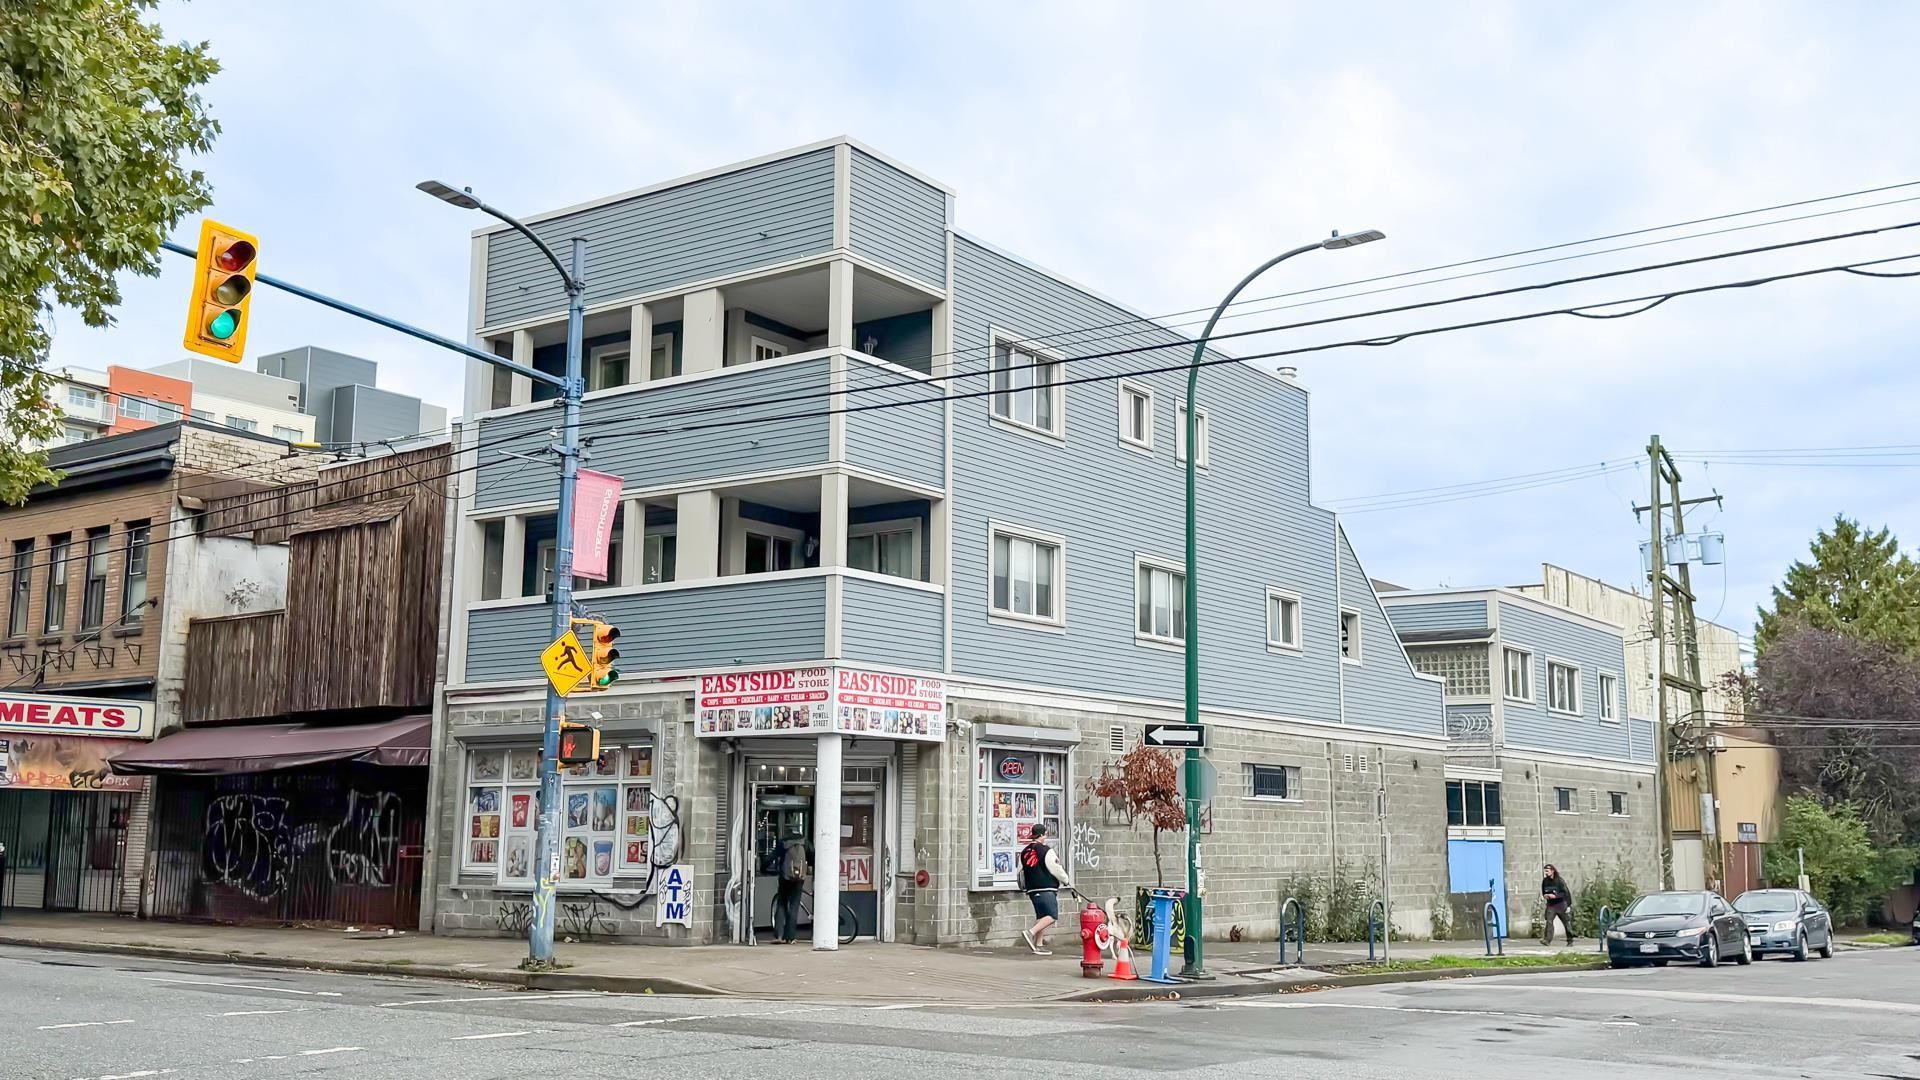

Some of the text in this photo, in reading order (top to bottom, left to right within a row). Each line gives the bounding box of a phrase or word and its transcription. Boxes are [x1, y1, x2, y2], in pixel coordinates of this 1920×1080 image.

[801, 669, 827, 678] FOOD
[701, 671, 795, 694] EASTSIDE
[798, 679, 829, 688] STORE
[838, 671, 917, 696] EASTSIDE
[921, 680, 941, 689] FOOD
[919, 690, 943, 699] STORE
[0, 702, 125, 728] MEATS
[1002, 762, 1024, 775] OPEN
[102, 776, 129, 786] ORK
[666, 868, 684, 920] ATM
